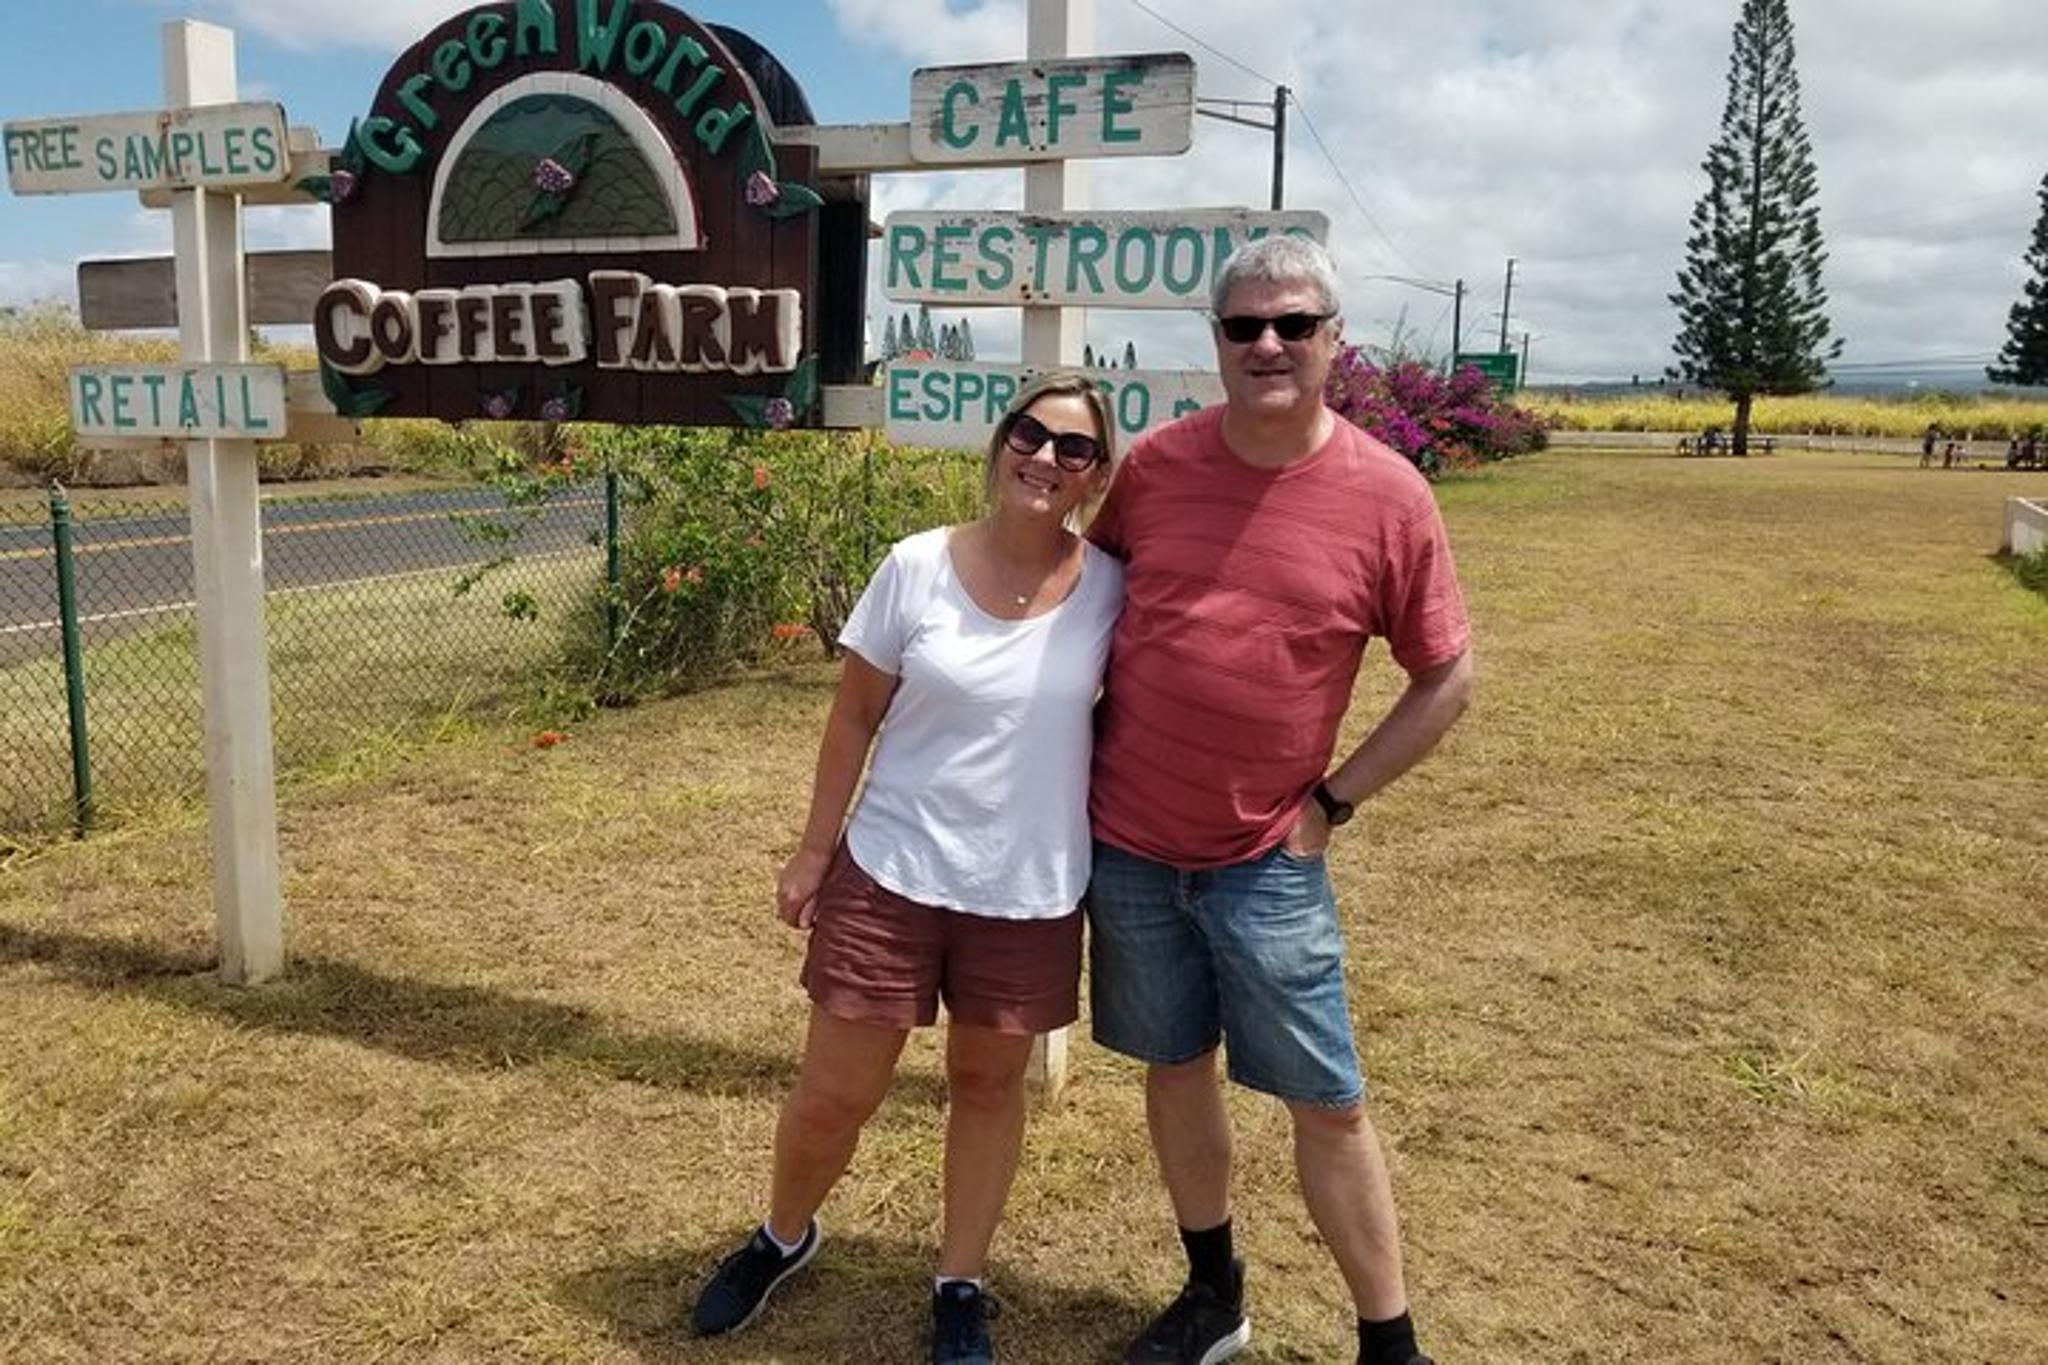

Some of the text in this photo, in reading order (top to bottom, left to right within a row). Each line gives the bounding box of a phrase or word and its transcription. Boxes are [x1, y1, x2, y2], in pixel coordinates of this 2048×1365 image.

[356, 0, 754, 173] Green World
[942, 69, 1145, 149] CAFE
[5, 125, 277, 181] FREE SAMPLES
[886, 225, 1316, 295] RESTROO
[315, 272, 798, 372] COFFEE FARM
[79, 373, 268, 429] RETAIL
[889, 369, 1150, 433] ESPRO
